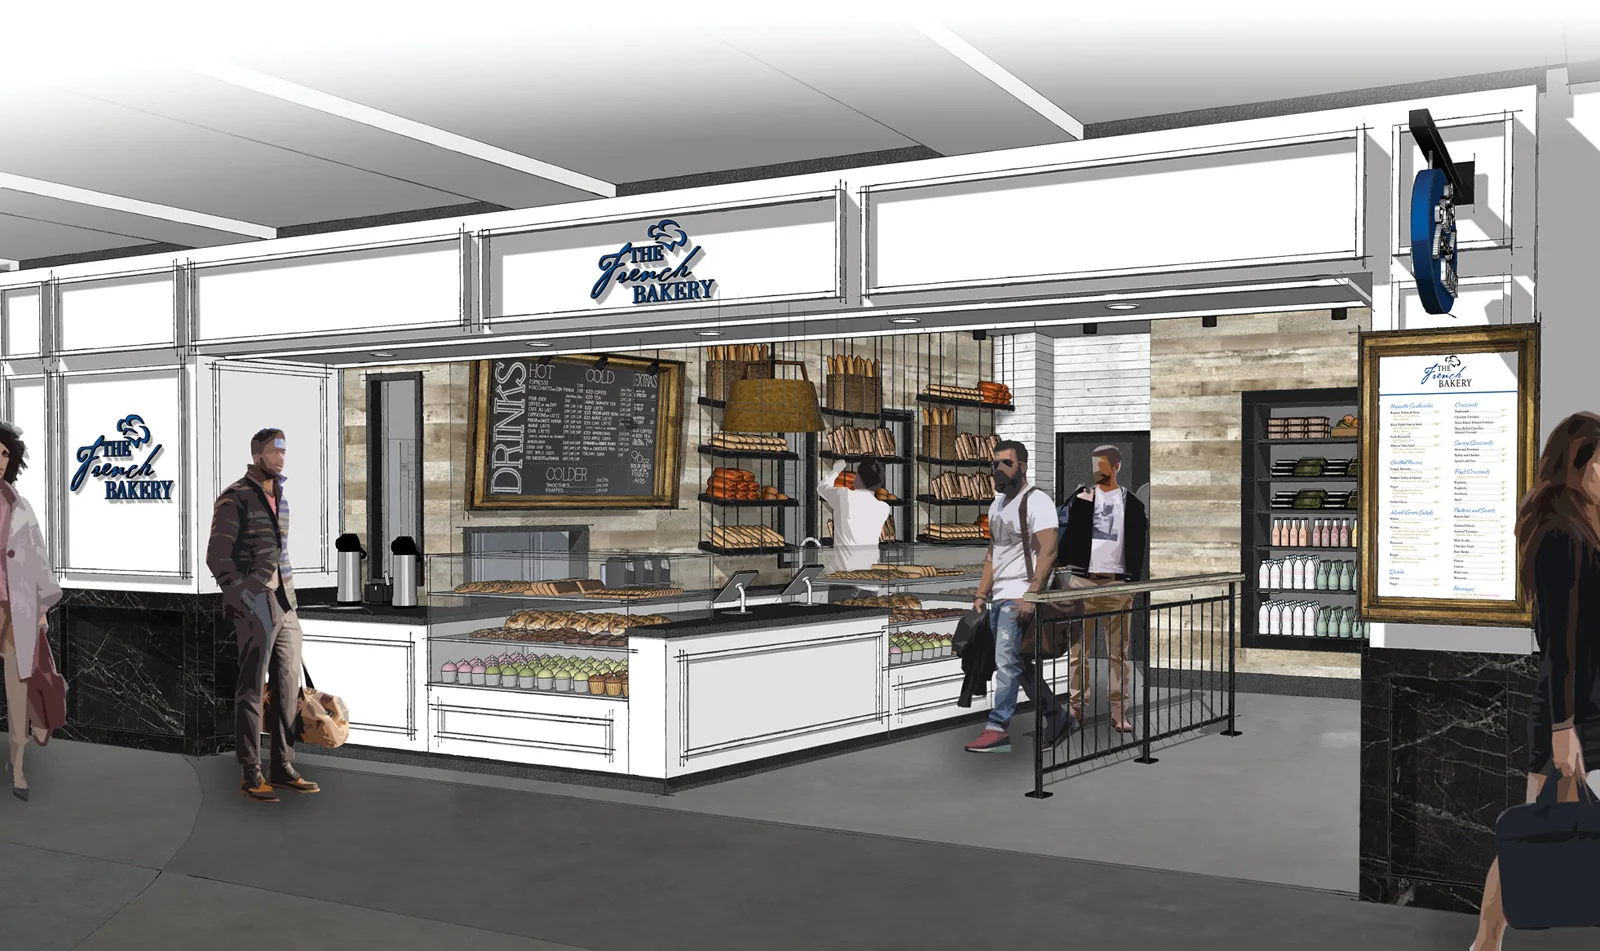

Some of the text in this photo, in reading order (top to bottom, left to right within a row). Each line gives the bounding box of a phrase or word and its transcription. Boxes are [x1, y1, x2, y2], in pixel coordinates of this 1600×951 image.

[631, 245, 664, 263] THE
[590, 242, 701, 299] French
[632, 279, 715, 303] BAKERY
[529, 363, 556, 380] HOT
[634, 374, 658, 388] EXTRAS
[1421, 363, 1467, 385] French
[1438, 379, 1472, 388] BAKERY
[491, 362, 526, 494] DRINKS
[103, 440, 132, 457] THE
[70, 435, 162, 492] French
[546, 467, 588, 482] COLDER
[104, 480, 174, 500] BAKERY
